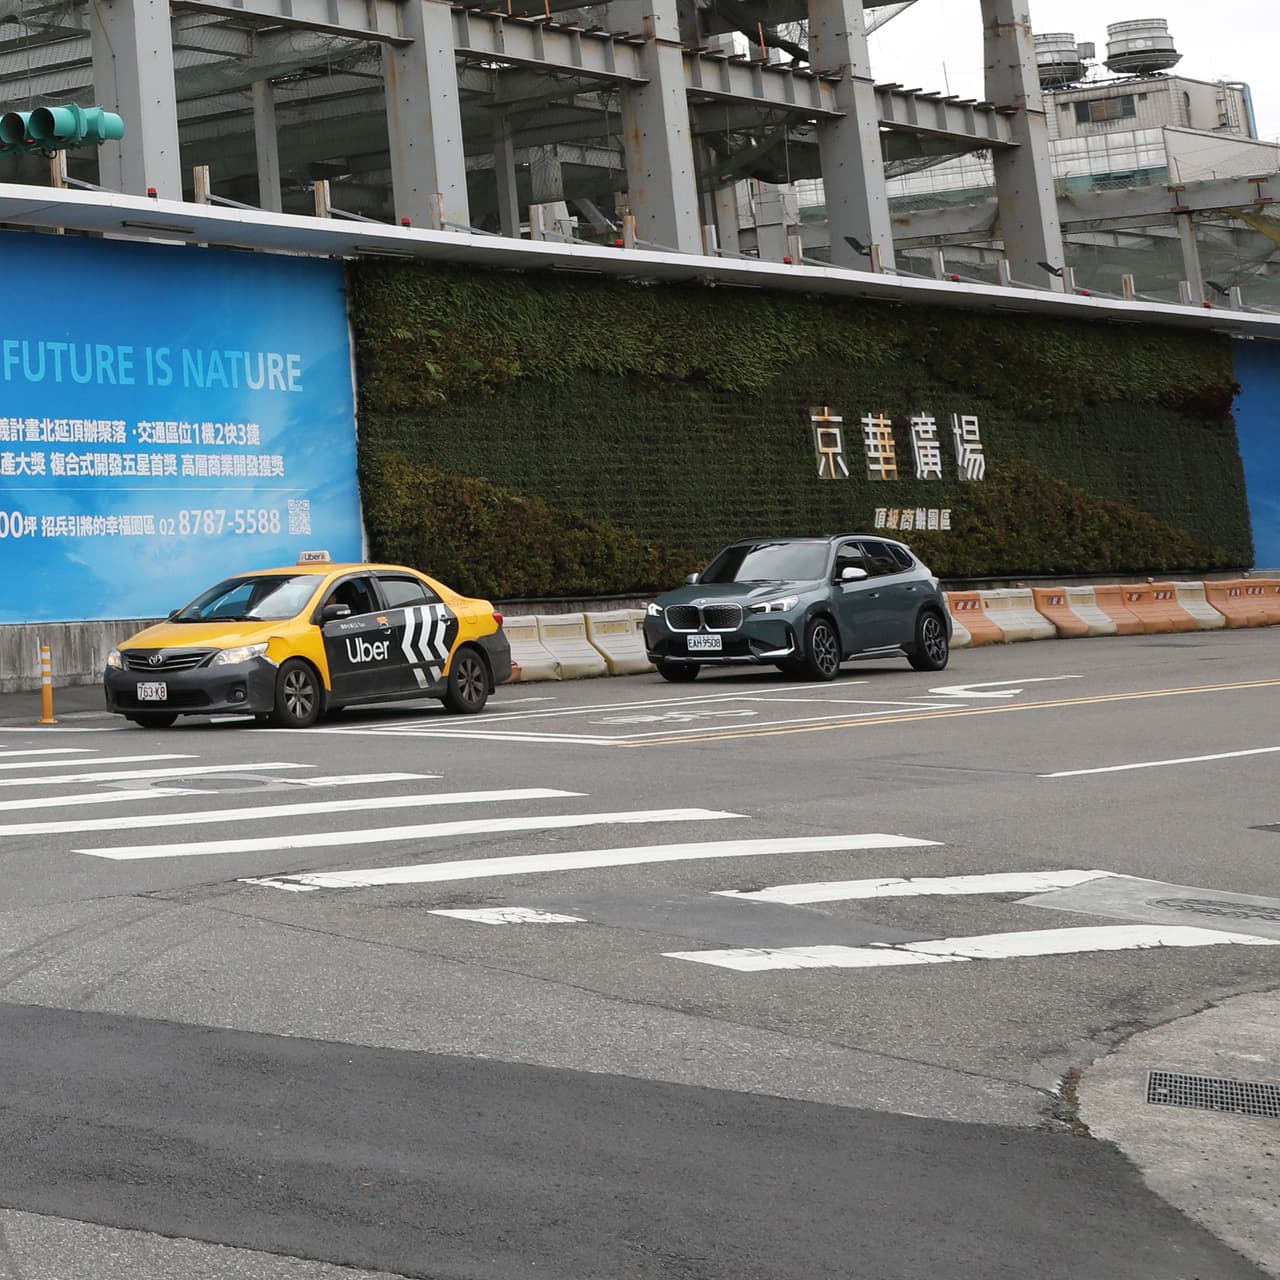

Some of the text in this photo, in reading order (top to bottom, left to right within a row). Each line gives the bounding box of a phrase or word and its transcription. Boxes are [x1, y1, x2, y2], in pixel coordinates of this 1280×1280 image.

[2, 338, 136, 386] FUTURE
[145, 346, 174, 387] IS
[182, 348, 304, 393] NATURE
[811, 406, 986, 481] 京華廣場
[41, 514, 155, 537] 招兵引將的幸福園區
[159, 519, 176, 536] 02
[178, 509, 281, 535] 8787-5588
[874, 507, 952, 531] 頂級商辦園區
[304, 553, 321, 561] Uber
[345, 637, 390, 664] Uber
